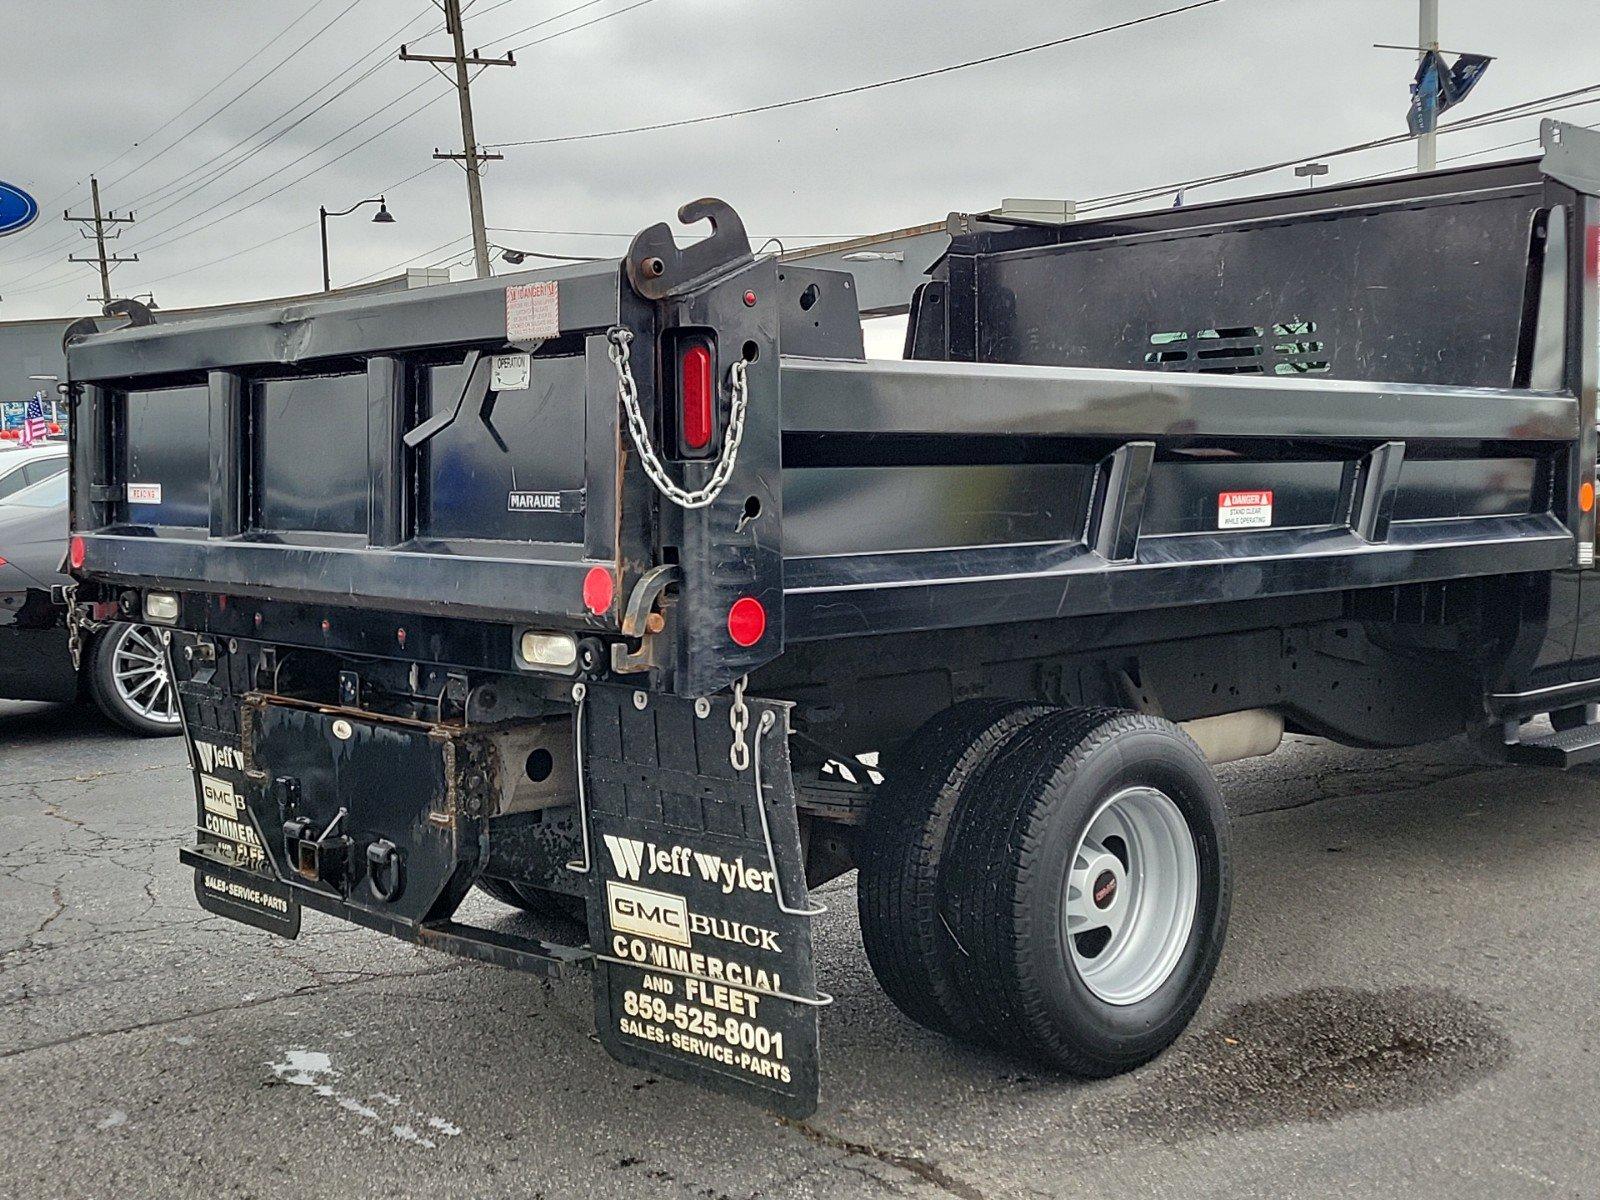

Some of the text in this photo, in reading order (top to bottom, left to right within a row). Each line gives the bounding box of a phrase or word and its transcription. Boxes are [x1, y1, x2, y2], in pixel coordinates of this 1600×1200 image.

[1230, 507, 1261, 516] STAND CLEAR
[1232, 494, 1260, 505] DANGER
[213, 745, 234, 768] Jeff
[205, 785, 232, 806] GMC
[647, 842, 692, 877] Jeff
[693, 851, 774, 894] Wyler
[614, 897, 680, 928] GMC
[689, 912, 783, 953] BUICK
[613, 935, 781, 992] COMMERCIAL
[642, 974, 760, 1018] AND FLEET
[623, 990, 784, 1060] 859-525-8001
